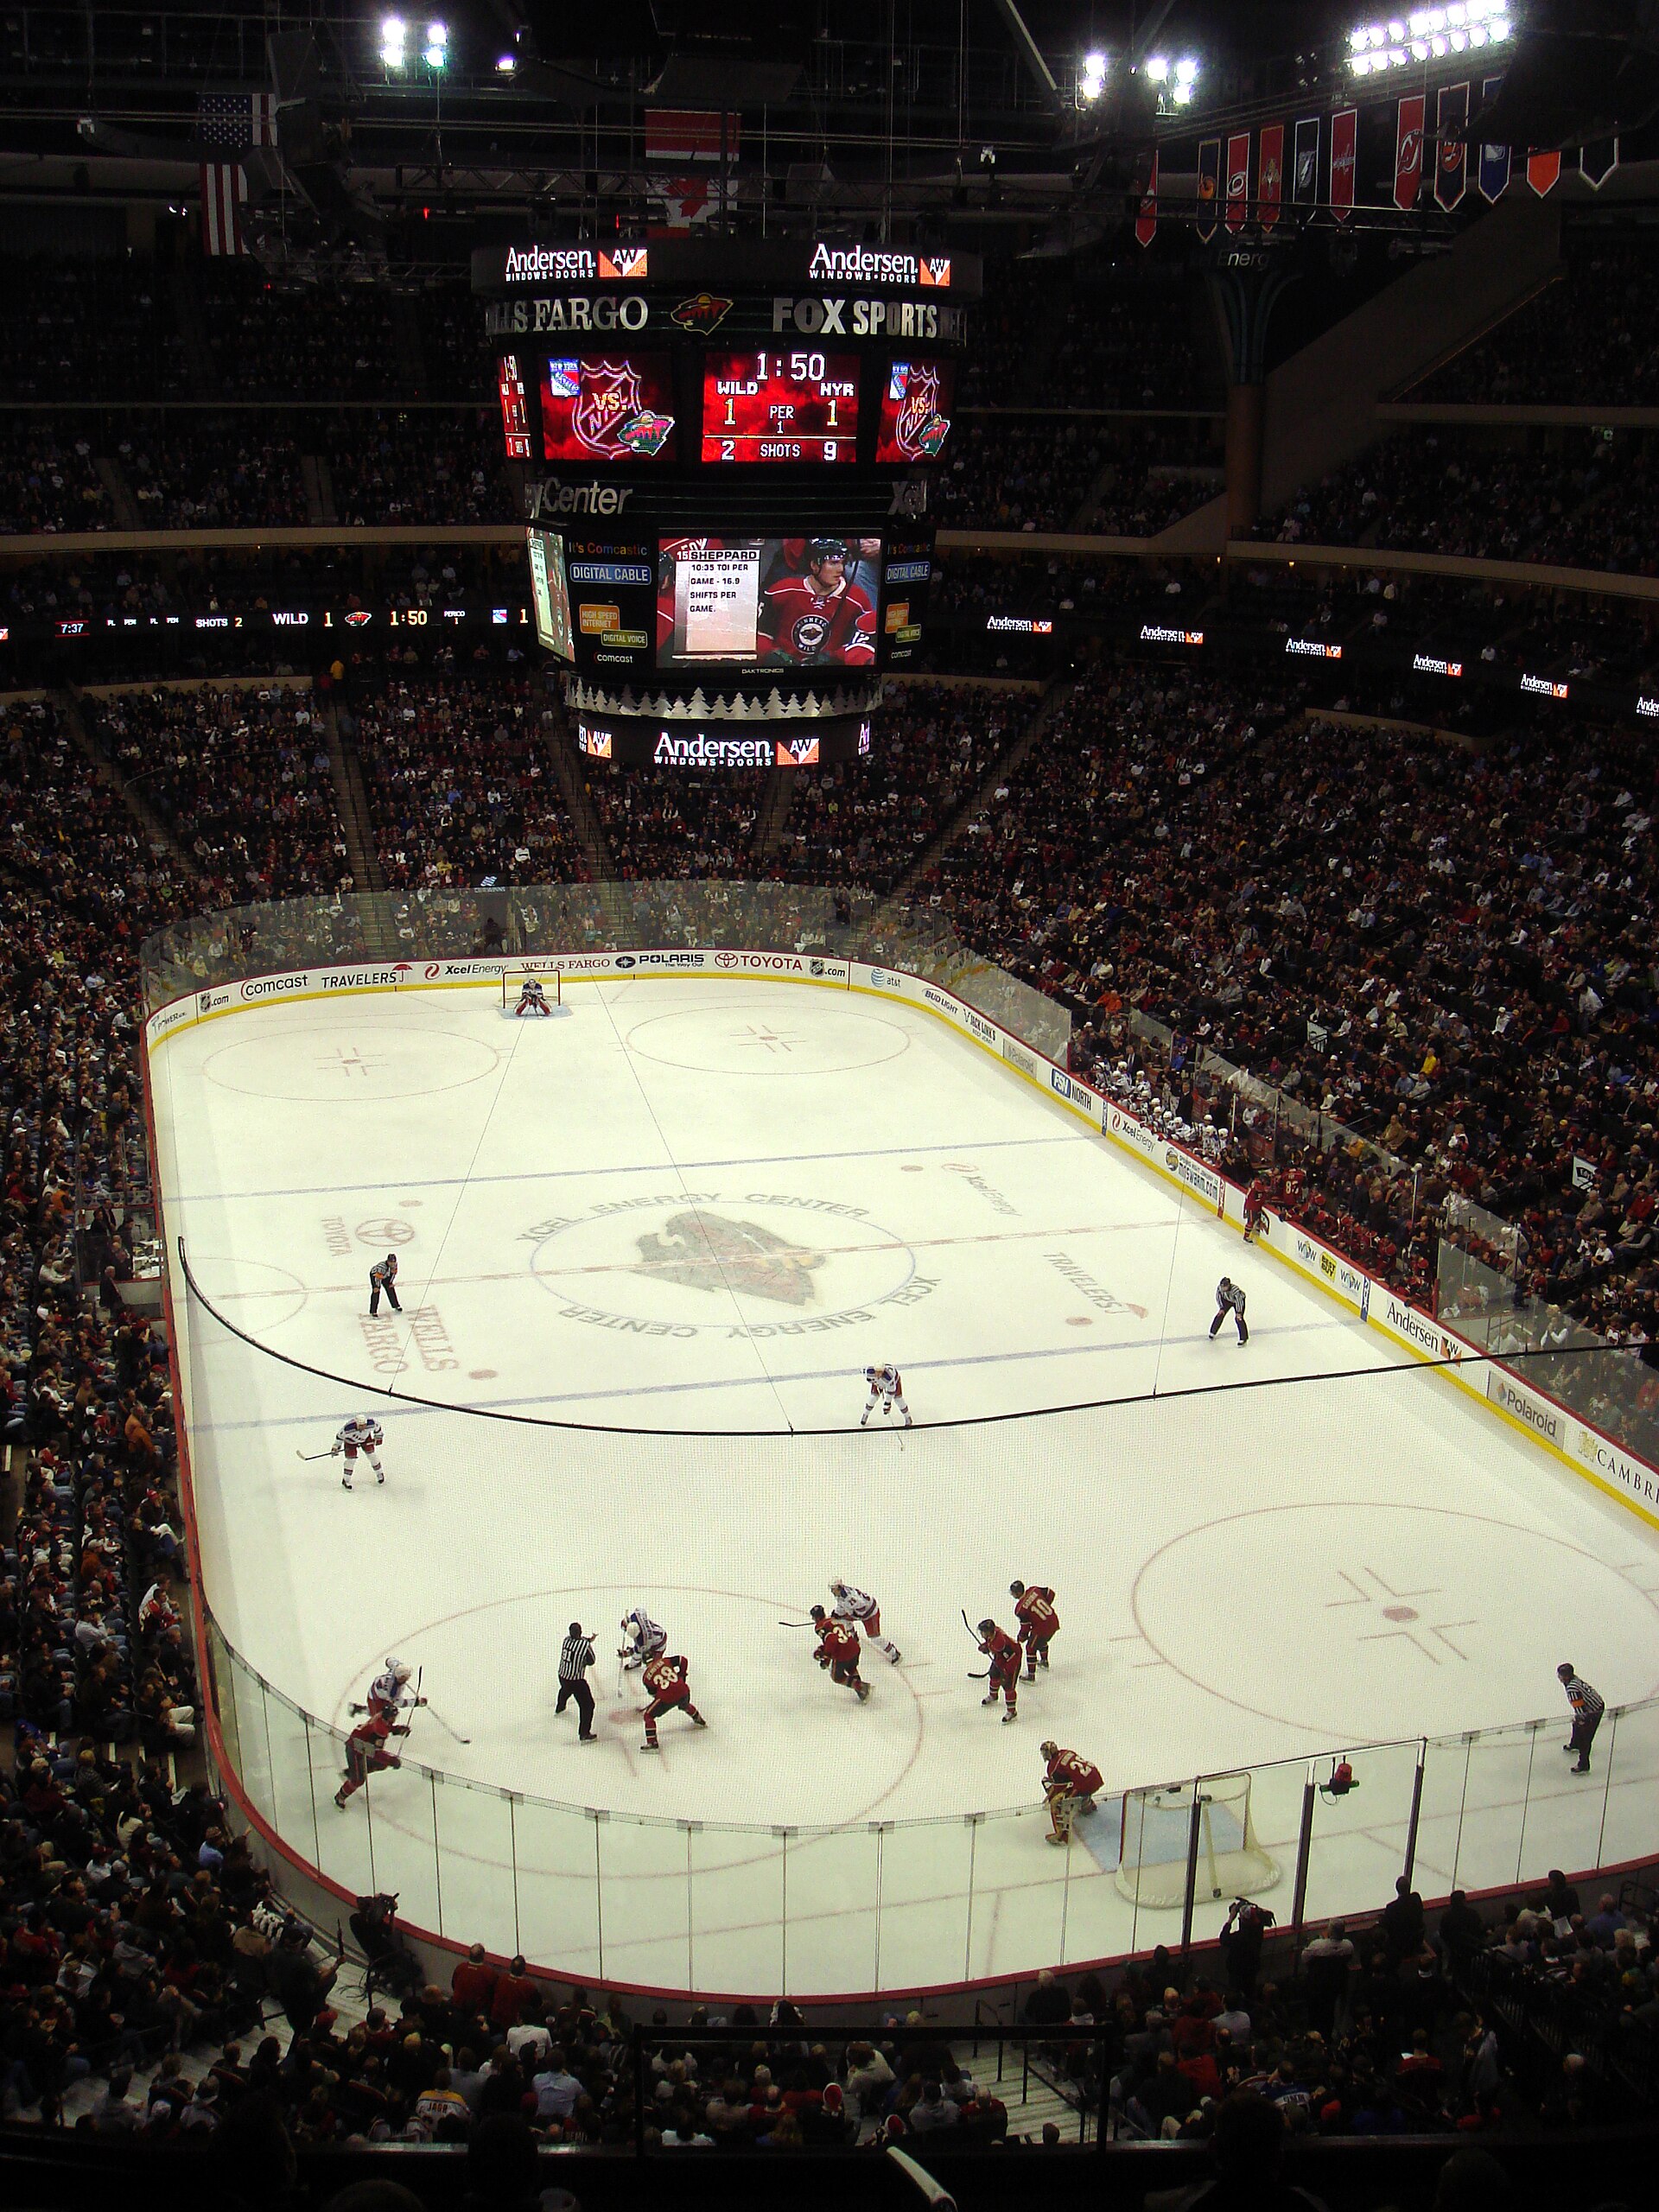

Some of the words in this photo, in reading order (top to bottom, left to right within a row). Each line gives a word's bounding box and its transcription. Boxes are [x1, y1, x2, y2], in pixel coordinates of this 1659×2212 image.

[532, 296, 648, 332] FARGO
[772, 297, 846, 334] FOX
[853, 301, 938, 338] SPORTS
[757, 353, 826, 381] 1:50
[717, 381, 759, 395] WILD
[820, 382, 854, 397] NYR
[724, 398, 736, 425] 1
[769, 406, 795, 419] PER
[827, 400, 838, 426] 1
[778, 422, 784, 434] 1
[721, 441, 735, 461] 2
[760, 442, 801, 458] SHOTS
[823, 442, 837, 461] 9
[543, 477, 633, 515] Center
[569, 542, 585, 554] It's
[588, 543, 647, 556] Comcastic
[677, 550, 689, 560] 15
[690, 550, 757, 560] SHEPPARD
[573, 566, 612, 581] DIGITAL
[614, 568, 648, 582] CABLE
[195, 617, 228, 628] SHOTS
[234, 617, 243, 627] 2
[272, 612, 309, 625] WILD
[324, 612, 333, 627] 1
[391, 611, 428, 626] 1:50
[598, 612, 618, 620] SPEED
[61, 623, 84, 633] 7:37
[603, 633, 626, 642] DIGITAL
[627, 635, 646, 644] VOICE
[596, 653, 633, 664] comcast
[521, 960, 565, 970] WELLS
[569, 958, 610, 969] FARGO
[639, 953, 704, 963] POLARIS
[741, 956, 803, 971] TOYOTA
[321, 971, 397, 988] TRAVELERS
[925, 990, 941, 1007] BUD
[941, 998, 958, 1014] LIGHT
[1071, 1084, 1092, 1111] NORTH
[516, 1214, 583, 1243] XCEL
[589, 1192, 721, 1213] ENERGY
[744, 1193, 870, 1217] CENTER
[321, 1216, 353, 1257] TOYOTA
[1321, 1262, 1333, 1277] BUY
[1322, 1255, 1336, 1271] BEST
[879, 1275, 942, 1307] XCEL
[1043, 1252, 1123, 1310] TRAVELERS
[558, 1306, 699, 1338] CENTER
[725, 1310, 877, 1338] ENERGY
[1387, 1302, 1439, 1352] Andersen
[358, 1311, 409, 1374] FARGO
[402, 1304, 461, 1372] WELLS
[1507, 1389, 1557, 1438] Polaroid
[1031, 1599, 1052, 1621] 10
